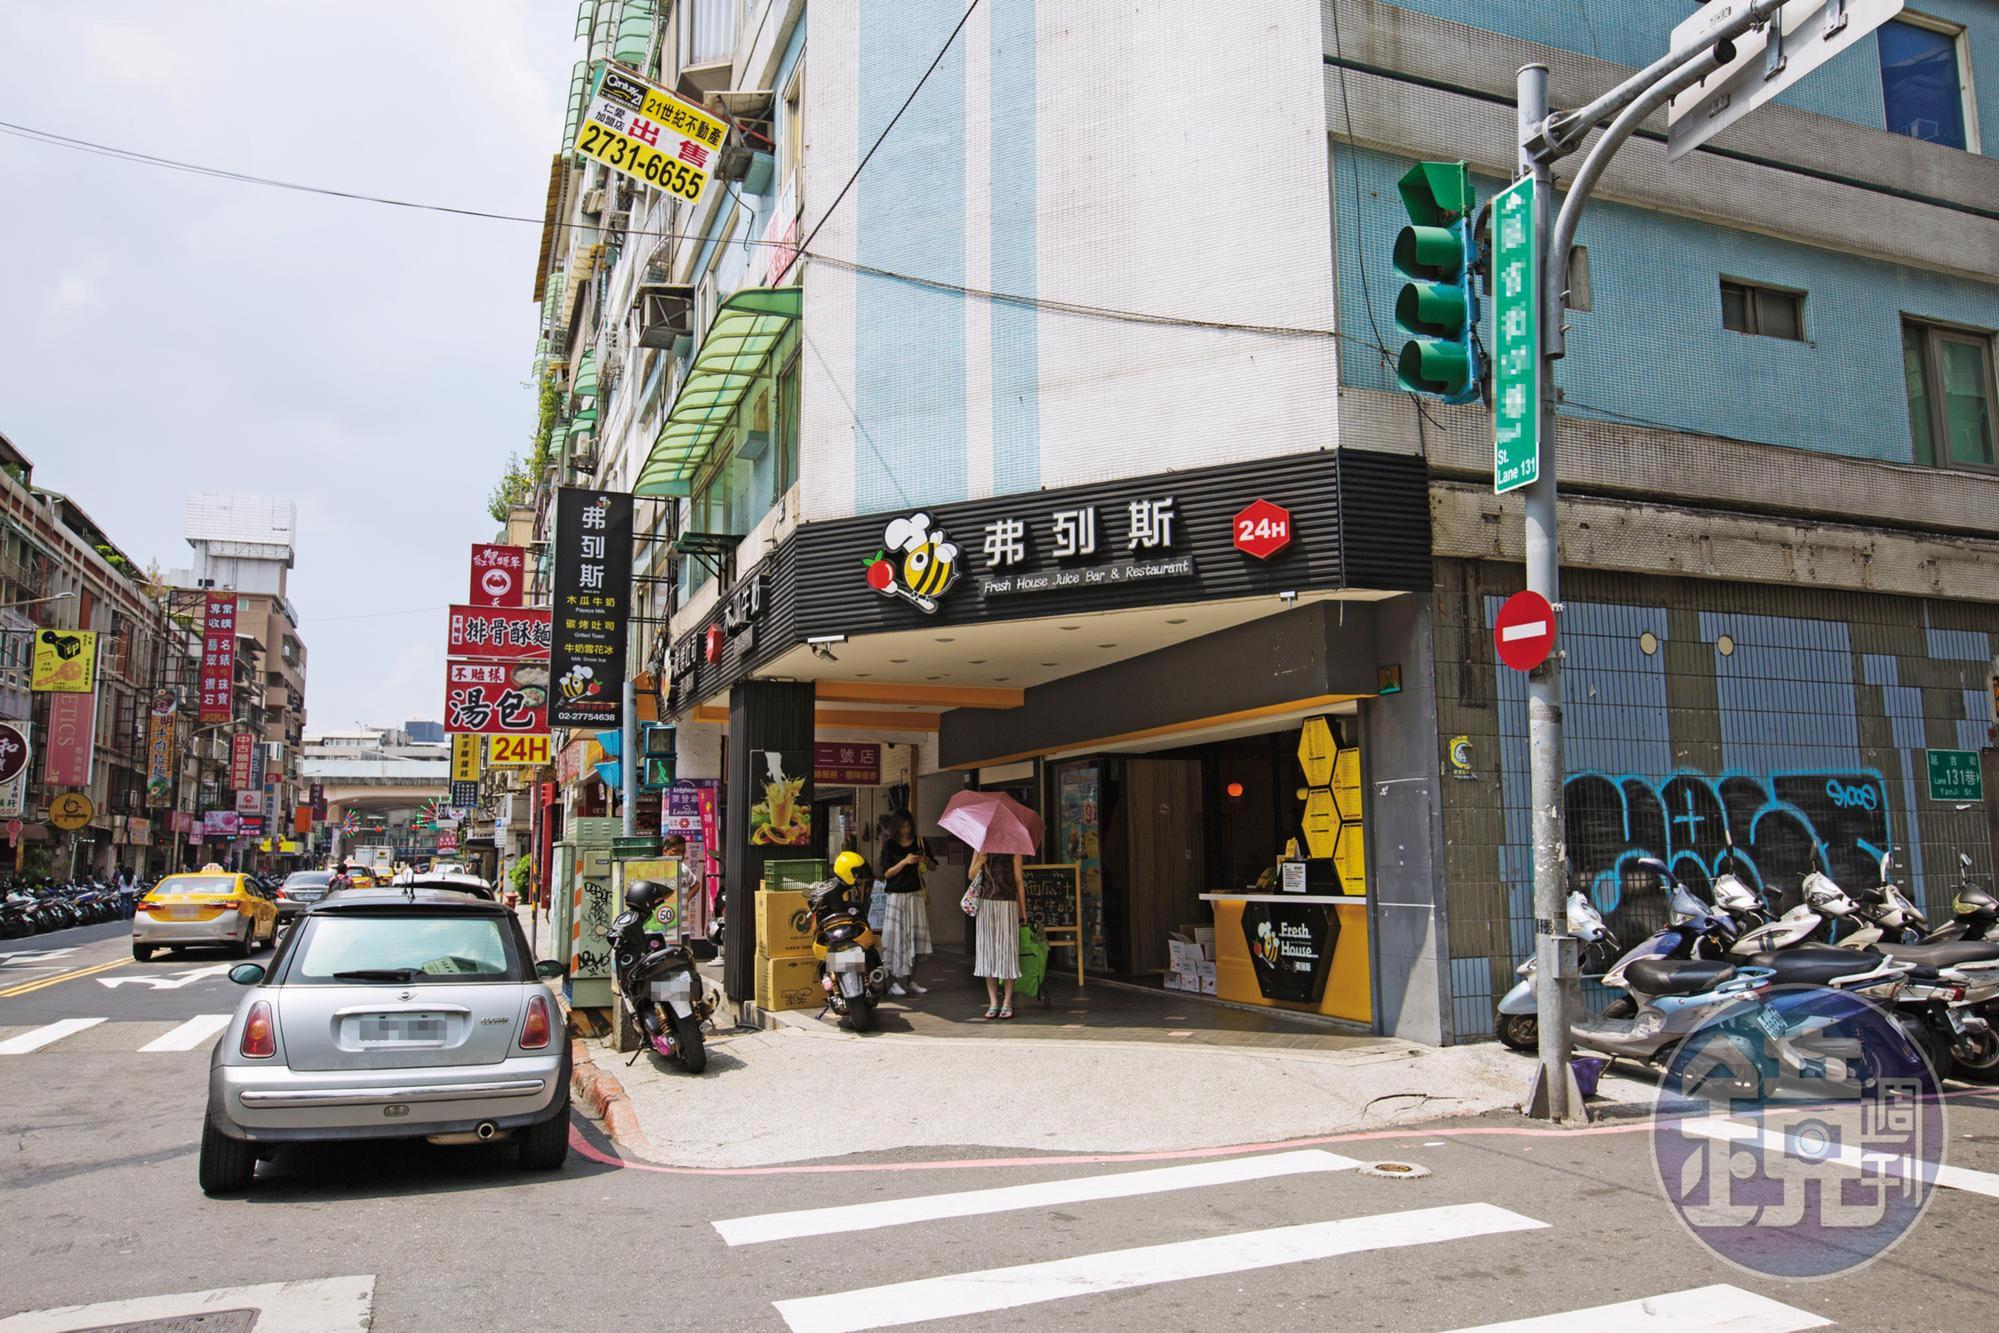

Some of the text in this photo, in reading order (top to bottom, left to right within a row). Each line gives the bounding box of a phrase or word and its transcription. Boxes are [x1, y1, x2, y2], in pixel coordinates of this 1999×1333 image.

[606, 73, 640, 96] Century
[631, 91, 643, 107] 21
[603, 102, 626, 119] 仁愛
[594, 111, 625, 132] 加盟店
[646, 98, 723, 146] 21世紀不動產
[628, 117, 709, 168] 出售
[580, 124, 703, 199] 2731-6655
[1497, 449, 1510, 465] St.
[1498, 456, 1536, 485] Lane 131
[983, 496, 1175, 569] 弗列斯
[1238, 517, 1287, 543] 24H
[579, 506, 606, 588] 弗列斯
[983, 559, 1190, 594] Fresh House Juice Bar & Restaurant
[566, 595, 616, 608] 木瓜牛奶
[575, 607, 594, 615] Papaya
[208, 618, 233, 630] 收購
[466, 617, 551, 647] 排骨酥麵
[565, 619, 616, 631] 碳烤吐司
[564, 643, 615, 655] 牛奶雪花冰
[203, 679, 216, 705] 鑽石
[217, 679, 229, 705] 珠寶
[449, 687, 535, 730] 湯包
[558, 711, 616, 722] 02-27754638
[494, 737, 548, 761] 24H
[819, 748, 875, 764] 二號店
[1930, 754, 1976, 766] 延吉街
[1934, 768, 1976, 786] Lane 131巷
[659, 909, 672, 921] 50
[1281, 922, 1310, 938] Fresh
[1281, 940, 1312, 957] House
